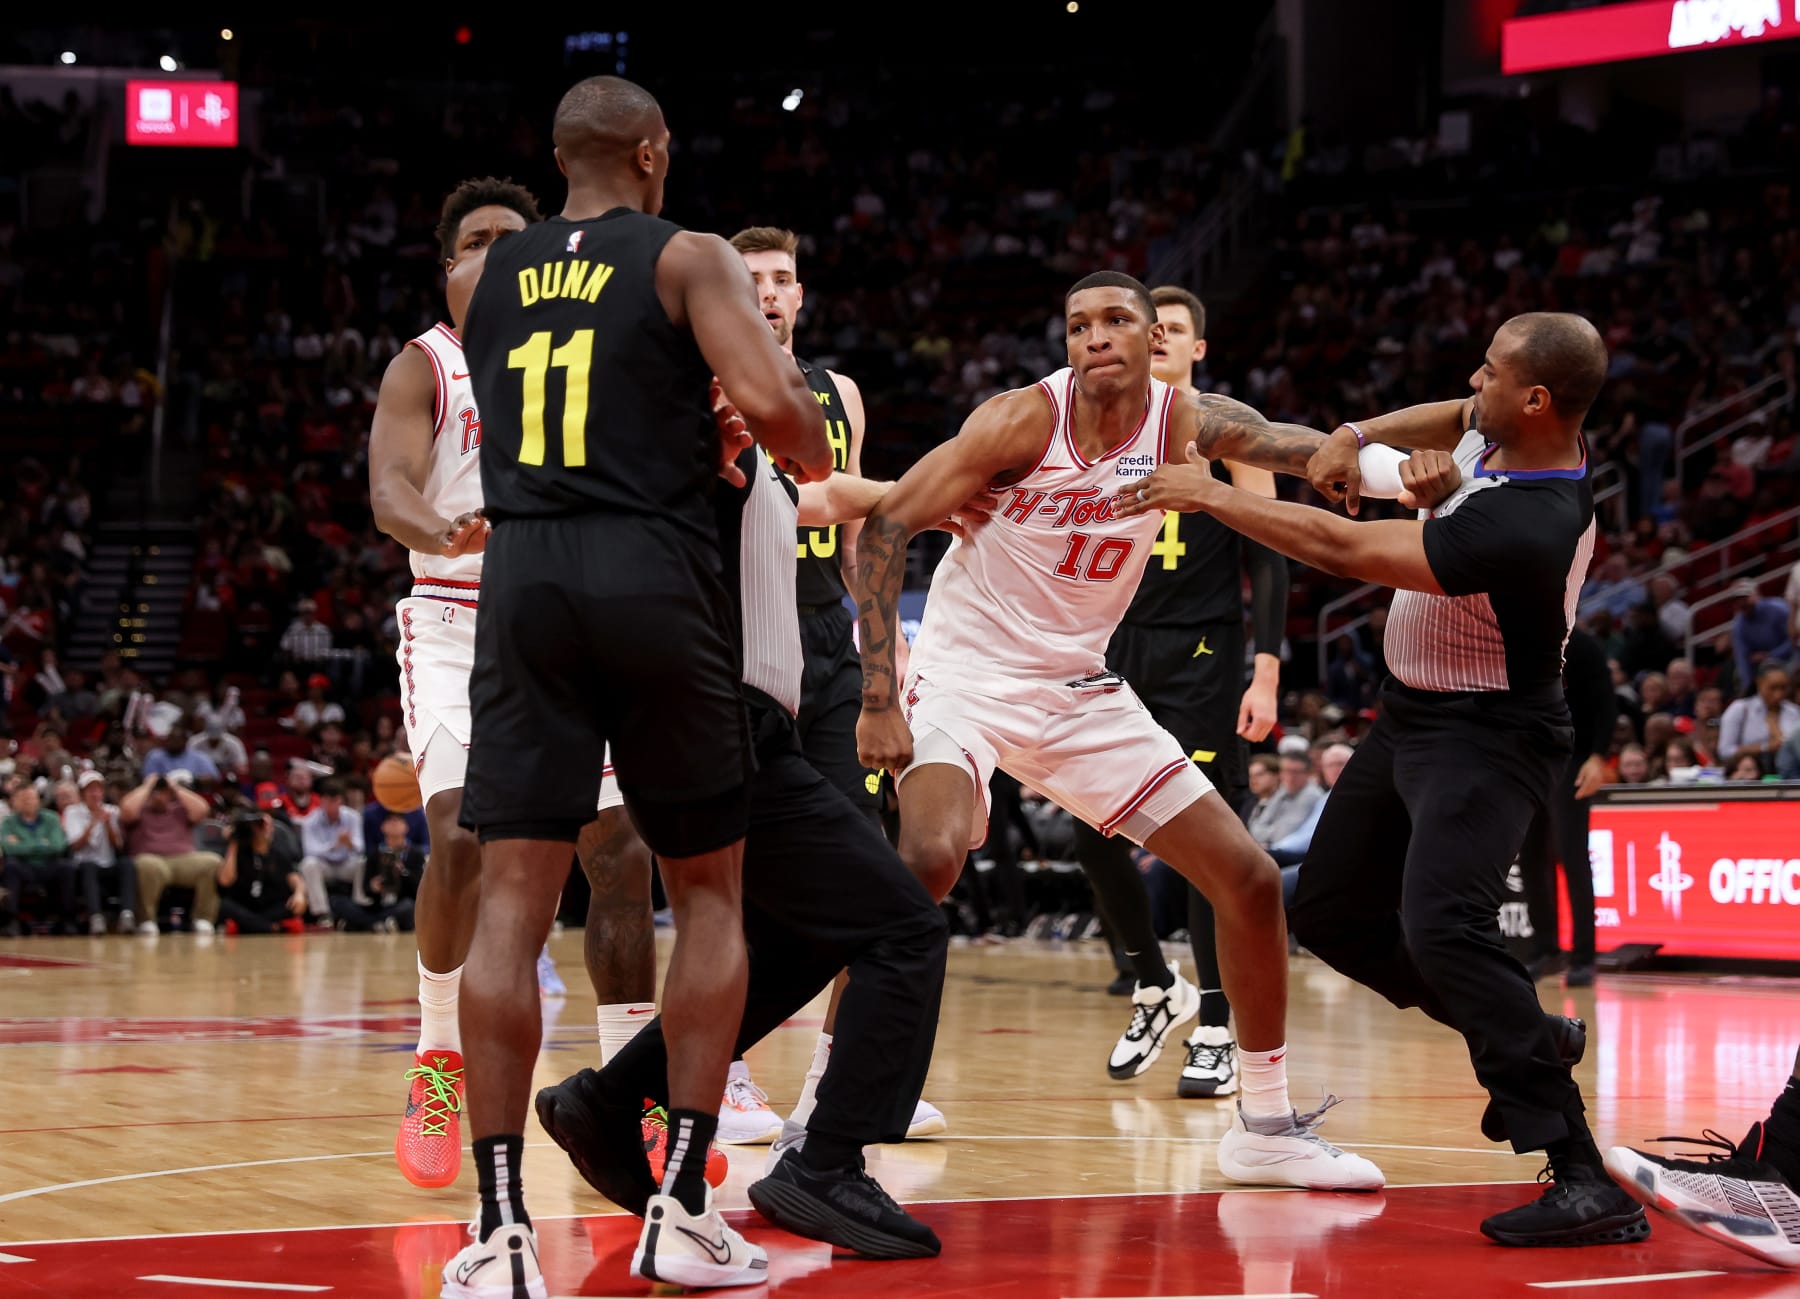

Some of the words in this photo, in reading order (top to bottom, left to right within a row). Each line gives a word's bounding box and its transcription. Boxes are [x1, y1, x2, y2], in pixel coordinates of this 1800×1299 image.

[518, 260, 615, 307] DUNN
[507, 329, 595, 467] 11
[1115, 466, 1153, 477] karma
[1118, 455, 1154, 466] credit
[1053, 531, 1136, 582] 10
[1708, 857, 1800, 906] OFFIC
